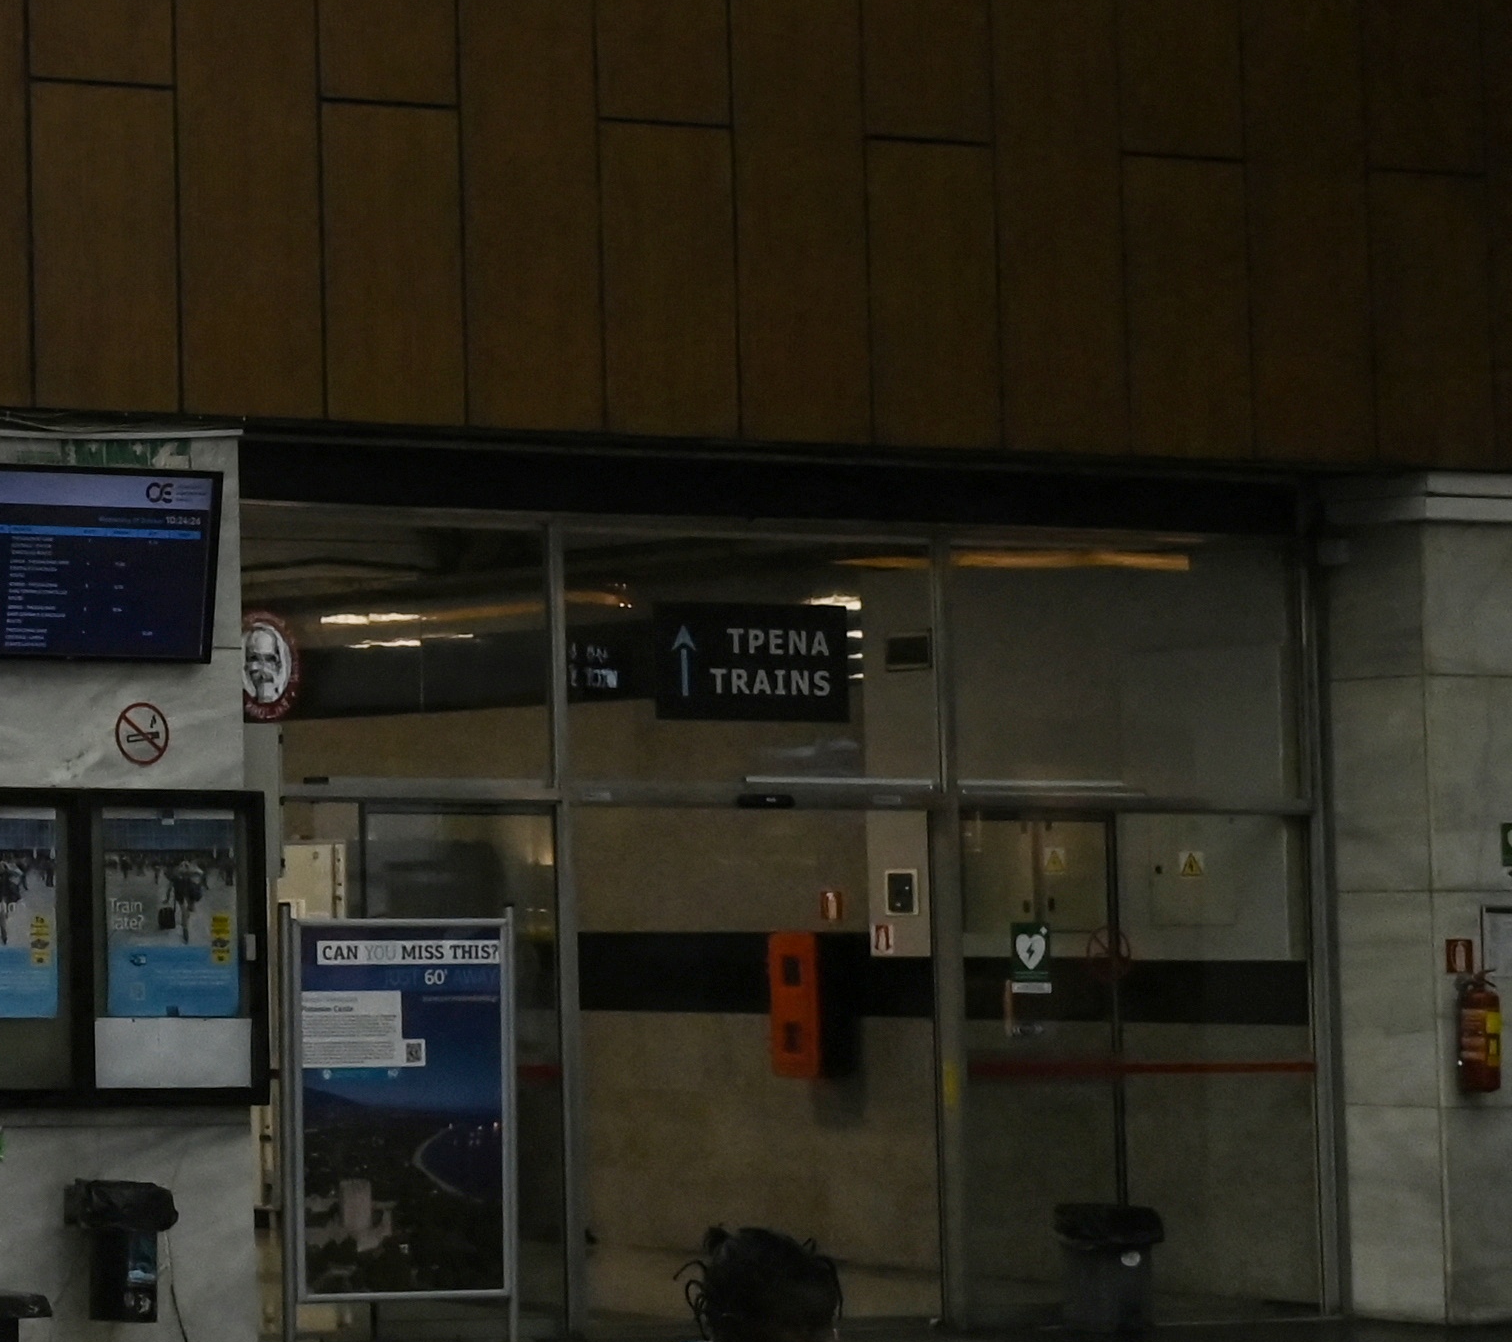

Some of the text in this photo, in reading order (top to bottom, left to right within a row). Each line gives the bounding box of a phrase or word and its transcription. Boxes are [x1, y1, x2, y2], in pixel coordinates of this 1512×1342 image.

[726, 628, 830, 656] ΤΡΕΝΑ
[709, 668, 831, 696] TRAINS
[110, 898, 143, 913] Train
[323, 945, 499, 960] CAN YOU MISS THIS?
